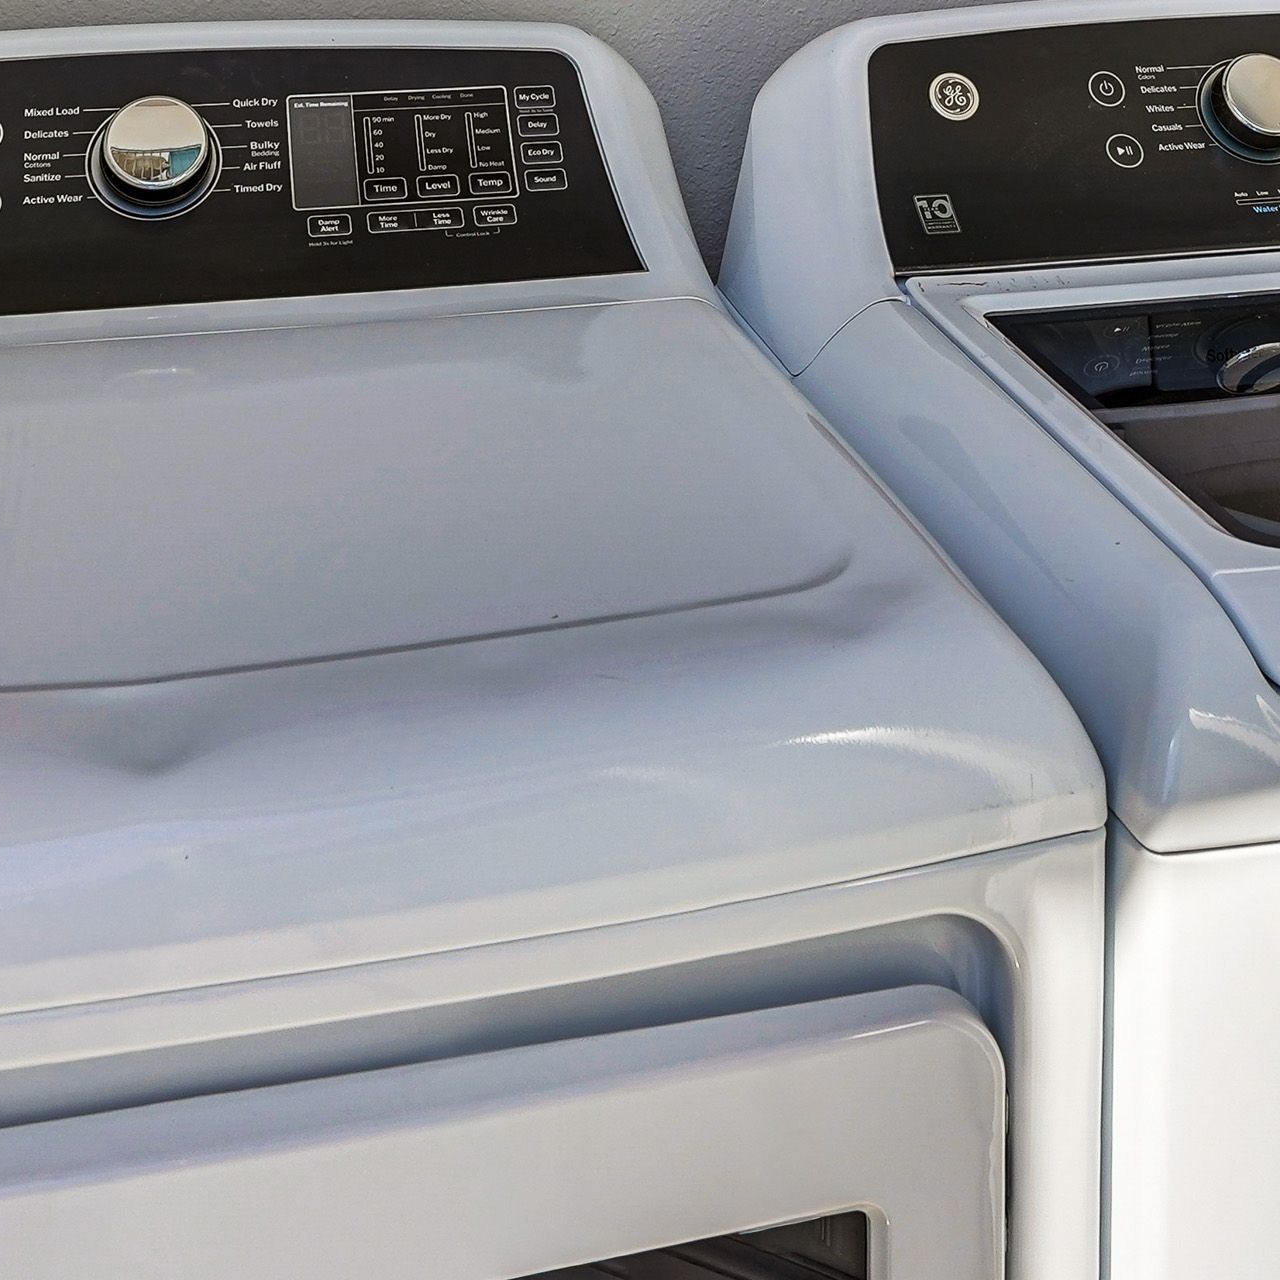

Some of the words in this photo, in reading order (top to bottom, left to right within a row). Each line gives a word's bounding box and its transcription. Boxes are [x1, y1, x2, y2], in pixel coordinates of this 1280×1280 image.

[1135, 65, 1165, 74] Normal
[1140, 85, 1177, 94] Delicates
[232, 99, 260, 108] Quick
[261, 97, 278, 107] Dry
[24, 107, 54, 117] Mixed
[55, 106, 80, 116] Load
[1145, 105, 1175, 113] Whites
[245, 119, 279, 128] Towels
[1151, 123, 1183, 132] Casuals
[24, 130, 69, 139] Delicates
[250, 141, 280, 150] Bulky
[1158, 143, 1184, 151] Active
[1184, 142, 1205, 150] Wear
[23, 151, 60, 161] Normal
[243, 162, 257, 171] Air
[259, 161, 281, 170] Fluff
[23, 173, 61, 183] Sanitize
[477, 178, 503, 187] Temp
[534, 175, 557, 183] Sound
[234, 183, 264, 193] Timed
[265, 183, 283, 192] Dry
[373, 184, 397, 193] Time
[425, 181, 451, 190] Level
[22, 195, 55, 205] Active
[56, 194, 83, 203] Wear
[917, 199, 953, 219] 10
[1252, 205, 1279, 214] Water
